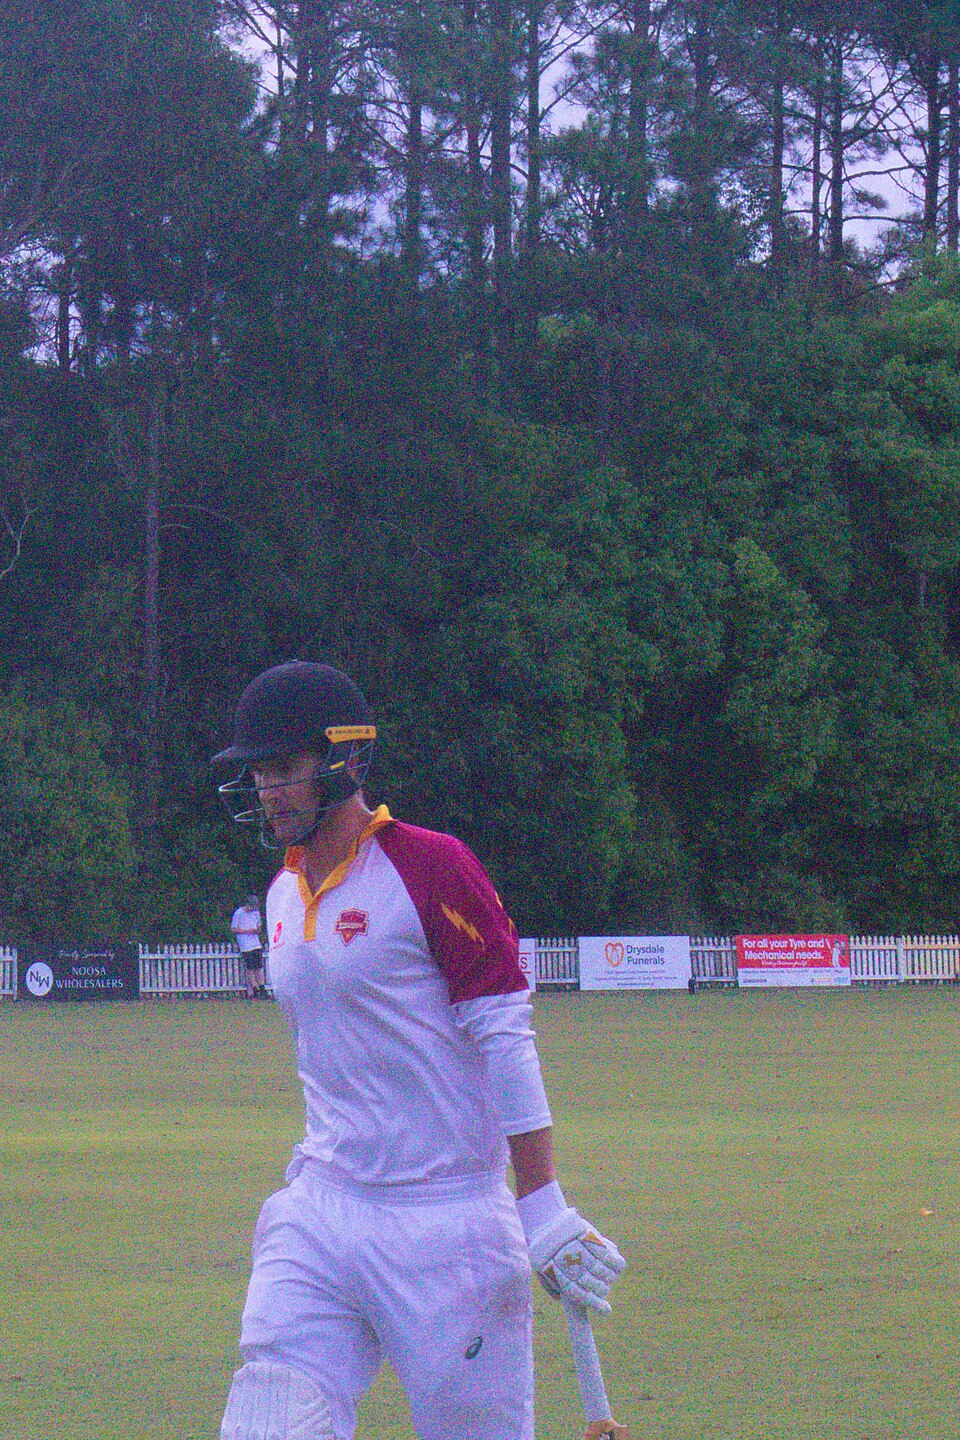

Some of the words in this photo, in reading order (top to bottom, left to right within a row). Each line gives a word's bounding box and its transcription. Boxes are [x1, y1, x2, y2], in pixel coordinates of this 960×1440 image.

[742, 938, 755, 948] For
[757, 938, 768, 948] all
[769, 939, 788, 950] your
[789, 938, 806, 950] Tyre
[807, 938, 824, 948] and
[626, 945, 665, 957] Drysdale
[744, 950, 795, 960] Mechanical
[796, 950, 825, 960] needs.
[627, 956, 665, 965] Funerals
[72, 966, 107, 976] NOOSA
[54, 979, 124, 988] WHOLESALERS
